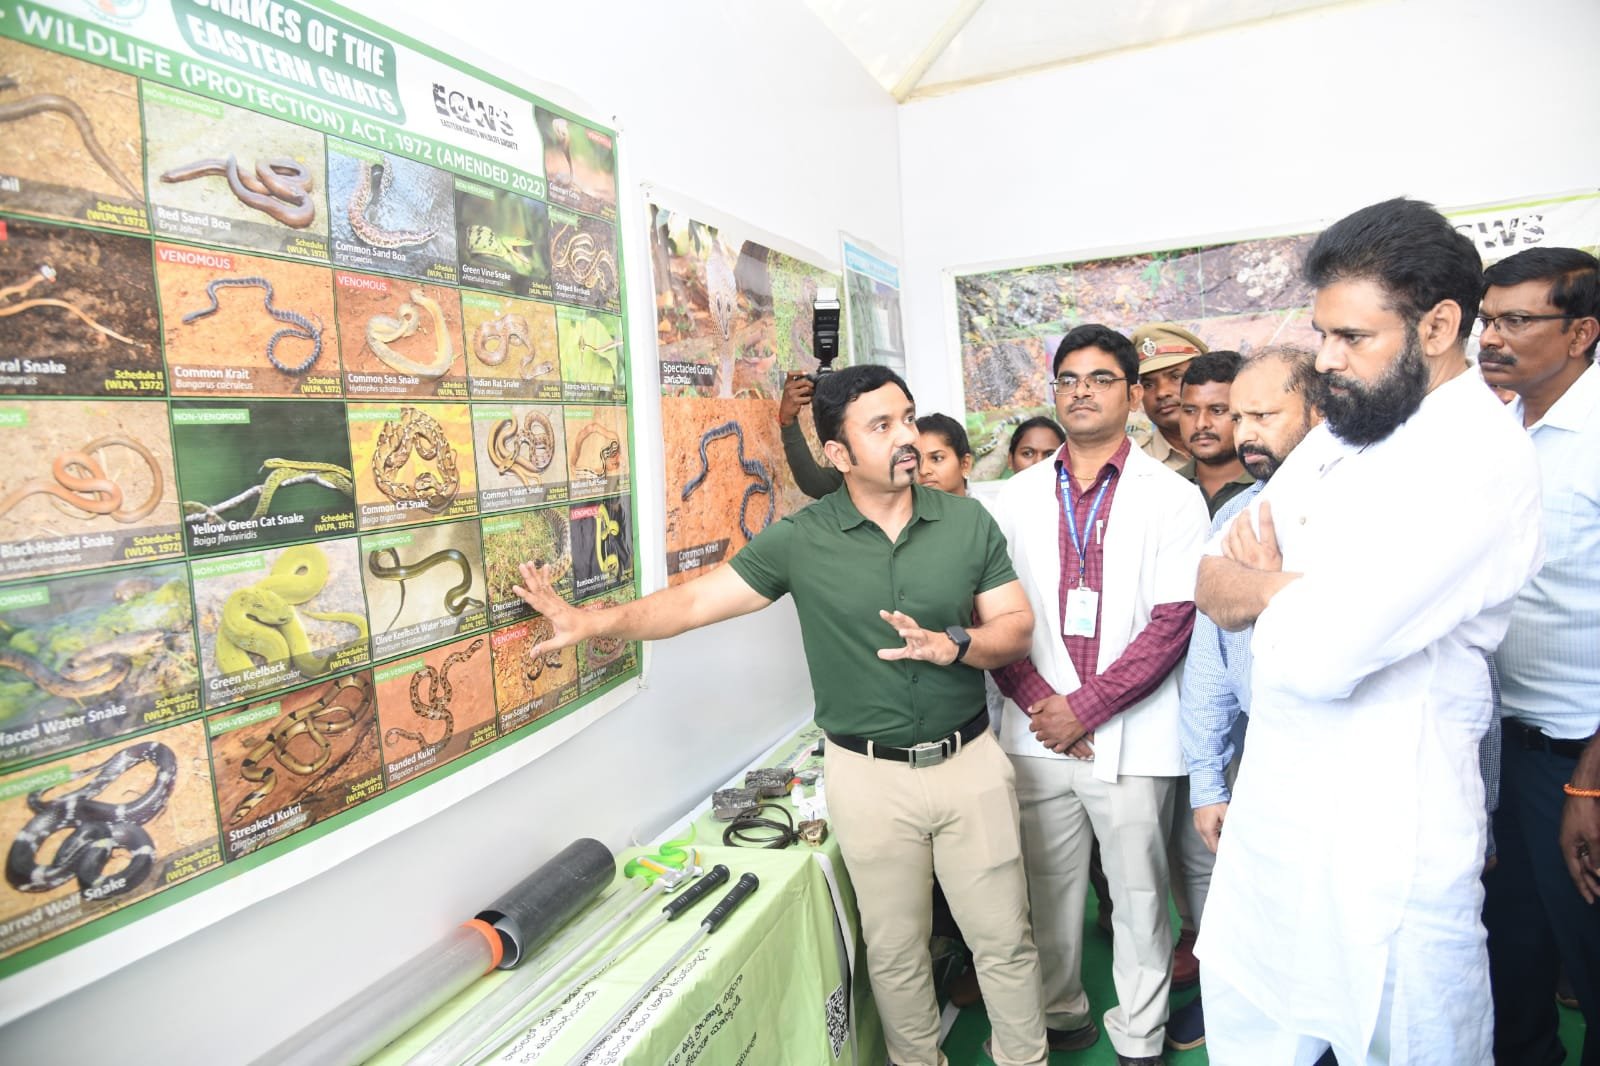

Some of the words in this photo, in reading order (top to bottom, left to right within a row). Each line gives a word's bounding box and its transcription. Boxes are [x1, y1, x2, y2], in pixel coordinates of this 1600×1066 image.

[307, 19, 338, 58] OF
[343, 33, 385, 78] THE
[187, 14, 318, 88] EASTERN
[318, 66, 398, 115] GHATS
[17, 6, 172, 77] WILDLIFE
[180, 61, 345, 133] (PROTECTION)
[395, 132, 433, 161] 1972
[436, 146, 509, 185] (AMENDED
[512, 171, 545, 198] 2022)
[0, 175, 20, 193] ail
[96, 201, 138, 216] Schedule
[158, 207, 178, 220] Red
[182, 212, 209, 226] Sand
[211, 218, 231, 231] Boa
[296, 238, 324, 250] Schedule
[335, 241, 370, 256] Common
[372, 248, 391, 259] Sand
[392, 250, 406, 261] Boa
[159, 249, 231, 270] VENOMOUS
[462, 264, 480, 275] Green
[481, 267, 494, 278] Vine
[494, 271, 512, 281] Snake
[338, 276, 387, 291] VENOMOUS
[23, 359, 67, 374] Snake
[115, 370, 155, 379] Schedule
[174, 367, 223, 379] Common
[226, 368, 249, 379] Krait
[663, 362, 696, 374] Spectacled
[697, 365, 713, 376] Cobra
[105, 380, 137, 391] (WLPA,
[140, 381, 164, 391] 1972)
[176, 380, 215, 390] Bungarus
[306, 376, 334, 384] Schedule
[348, 373, 383, 385] Common
[384, 375, 398, 385] Sea
[399, 376, 419, 385] Snake
[473, 378, 492, 388] Indian
[493, 379, 503, 388] Rat
[504, 380, 520, 389] Snake
[301, 384, 323, 394] (WLPA,
[174, 412, 246, 421] NON-VENOMOUS
[482, 490, 508, 500] Common
[361, 503, 395, 515] Common
[396, 501, 408, 510] Cat
[409, 499, 429, 509] Snake
[191, 523, 226, 536] Yellow
[228, 519, 258, 531] Green
[260, 517, 276, 527] Cat
[277, 513, 304, 525] Snake
[314, 522, 338, 534] (WLPA,
[338, 520, 355, 530] 1972)
[1, 537, 81, 558] Black-Headed
[82, 534, 115, 548] Snake
[193, 536, 217, 547] Boiga
[217, 530, 257, 545] flaviviridis
[125, 545, 157, 558] (WLPA,
[159, 542, 182, 553] 1972)
[678, 547, 704, 561] Common
[705, 543, 719, 553] Krait
[193, 558, 261, 576] NON-VENOMOUS
[492, 599, 520, 613] Checkered
[376, 634, 393, 645] Olive
[393, 627, 420, 640] Keelback
[420, 622, 439, 633] Water
[440, 616, 457, 627] Snake
[493, 630, 527, 645] VENOMOUS
[329, 657, 351, 670] (WLPA,
[210, 675, 241, 690] Green
[243, 662, 286, 681] Keelback
[210, 681, 257, 700] Rhabdophis
[42, 715, 87, 735] Water
[87, 703, 127, 723] Snake
[144, 706, 174, 723] (WLPA,
[176, 699, 199, 713] 1972)
[210, 707, 278, 733] NON-VENOMOUS
[388, 754, 416, 773] Banded
[417, 745, 436, 761] Kukri
[345, 790, 367, 805] (WLPA,
[367, 782, 383, 795] 1972)
[229, 814, 275, 842] Streaked
[276, 803, 302, 822] Kukri
[230, 833, 266, 852] Oligodon
[166, 864, 196, 884] (WLPA,
[197, 853, 221, 870] 1972)
[0, 909, 42, 936] arred
[45, 893, 81, 917] Wolf
[84, 877, 127, 902] Snake
